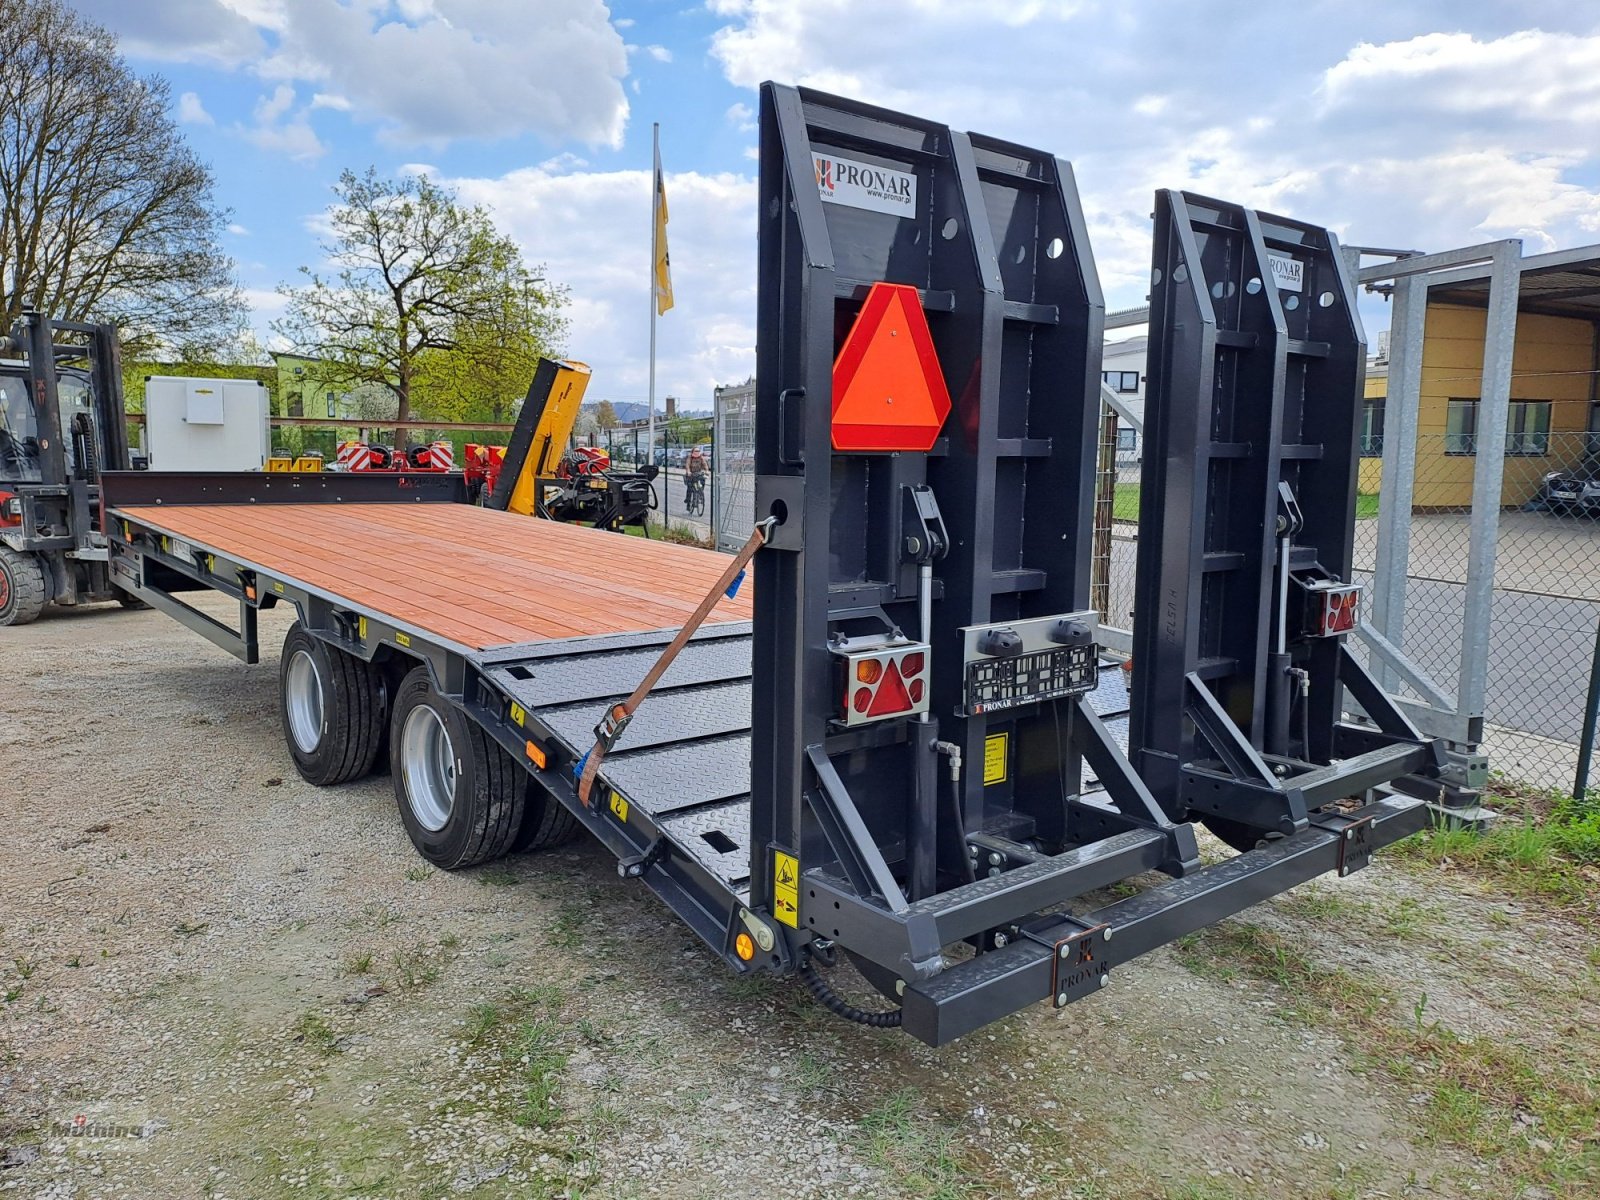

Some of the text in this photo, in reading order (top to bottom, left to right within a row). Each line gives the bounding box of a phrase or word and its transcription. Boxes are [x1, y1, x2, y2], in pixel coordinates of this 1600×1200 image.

[835, 162, 911, 197] PRONAR
[866, 188, 912, 205] www.pronar.pl
[1269, 258, 1301, 278] RONAR
[983, 699, 1012, 713] PRONAR
[1060, 960, 1107, 991] PRONAR
